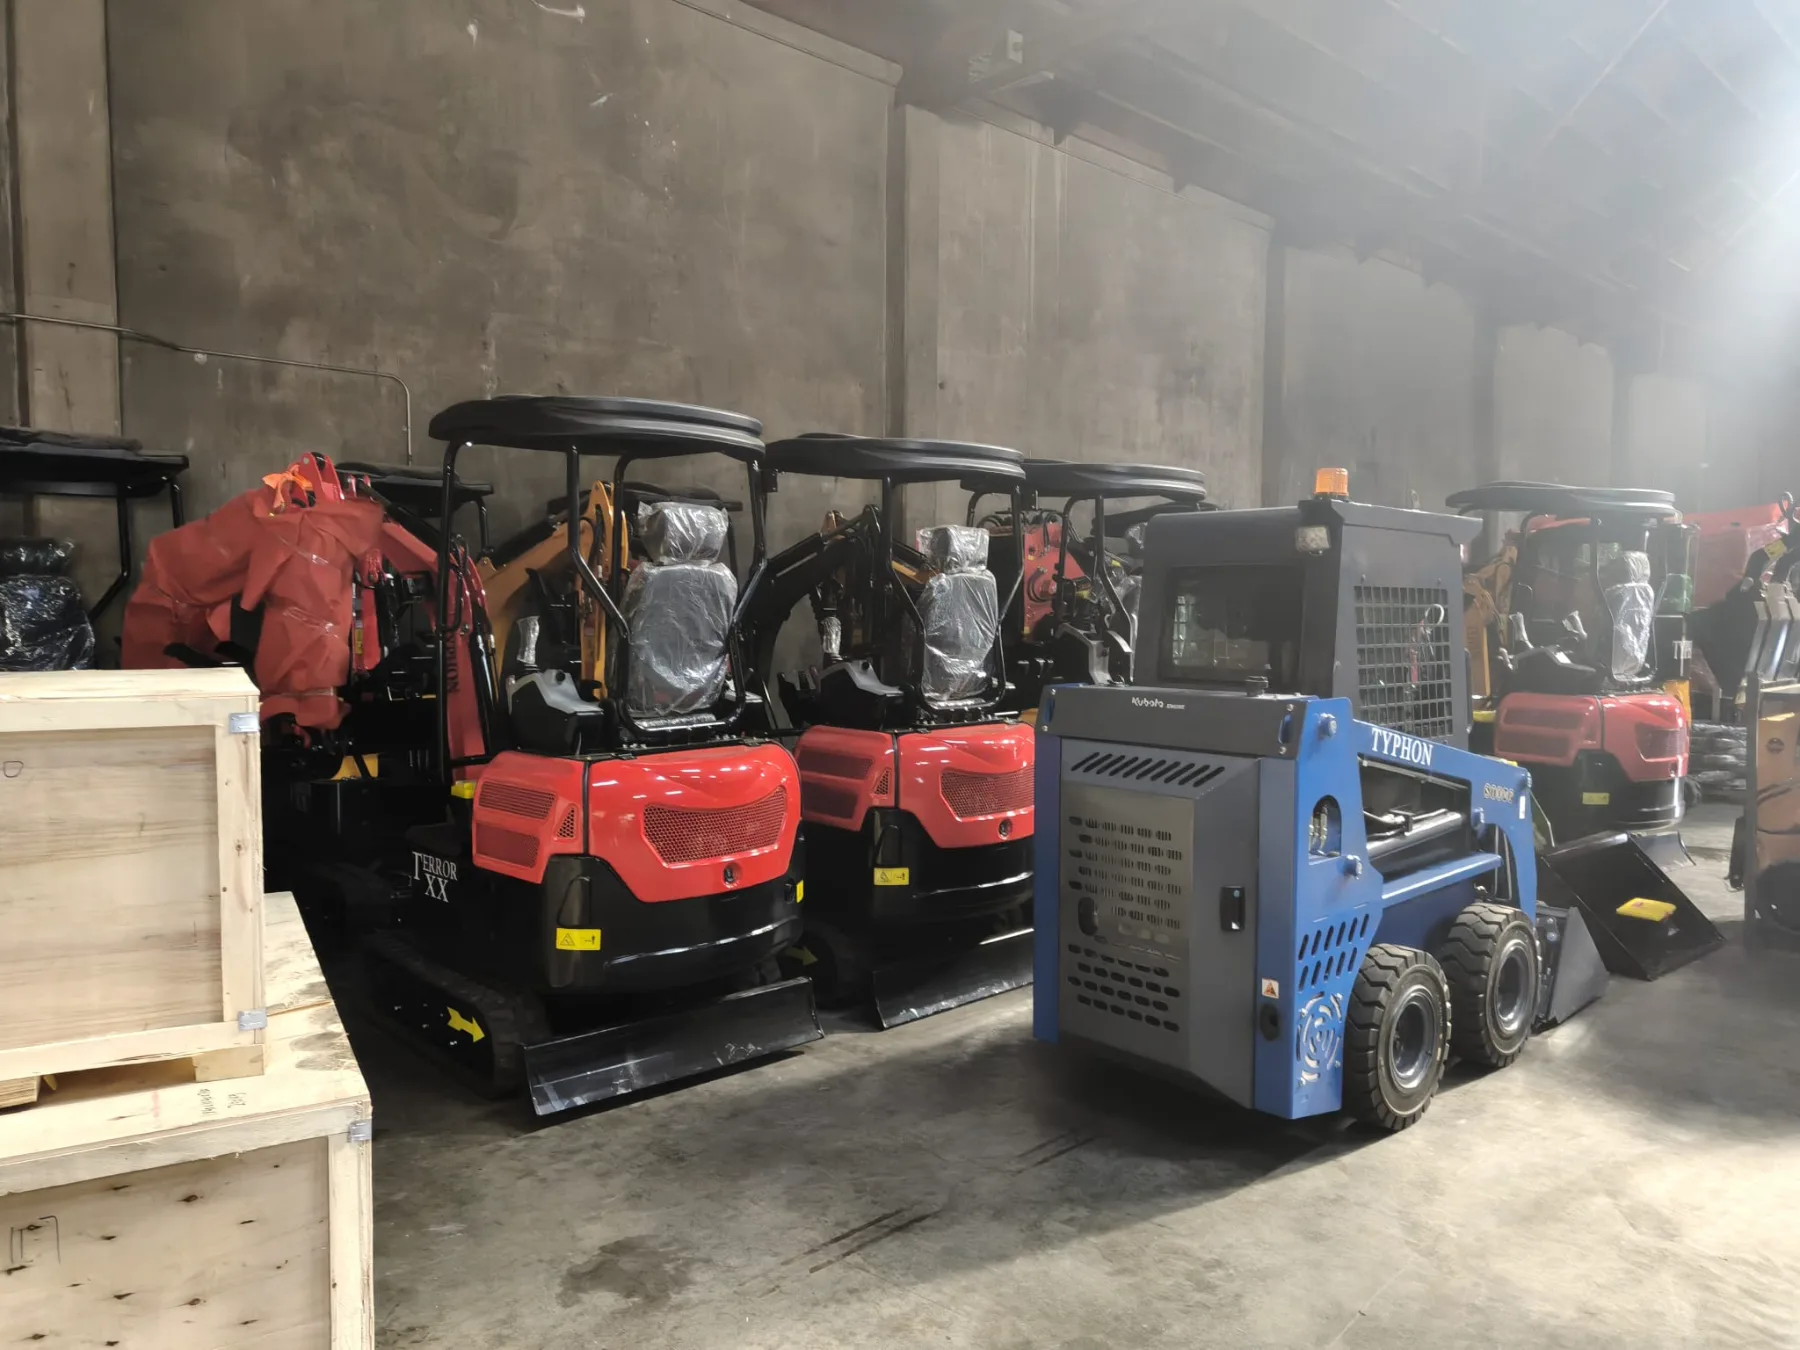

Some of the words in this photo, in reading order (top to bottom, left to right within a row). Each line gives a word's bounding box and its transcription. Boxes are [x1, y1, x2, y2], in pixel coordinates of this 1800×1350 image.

[1131, 696, 1164, 708] Kubota
[1371, 727, 1434, 767] TYPHON
[411, 850, 458, 881] TERROR
[424, 872, 449, 903] XX
